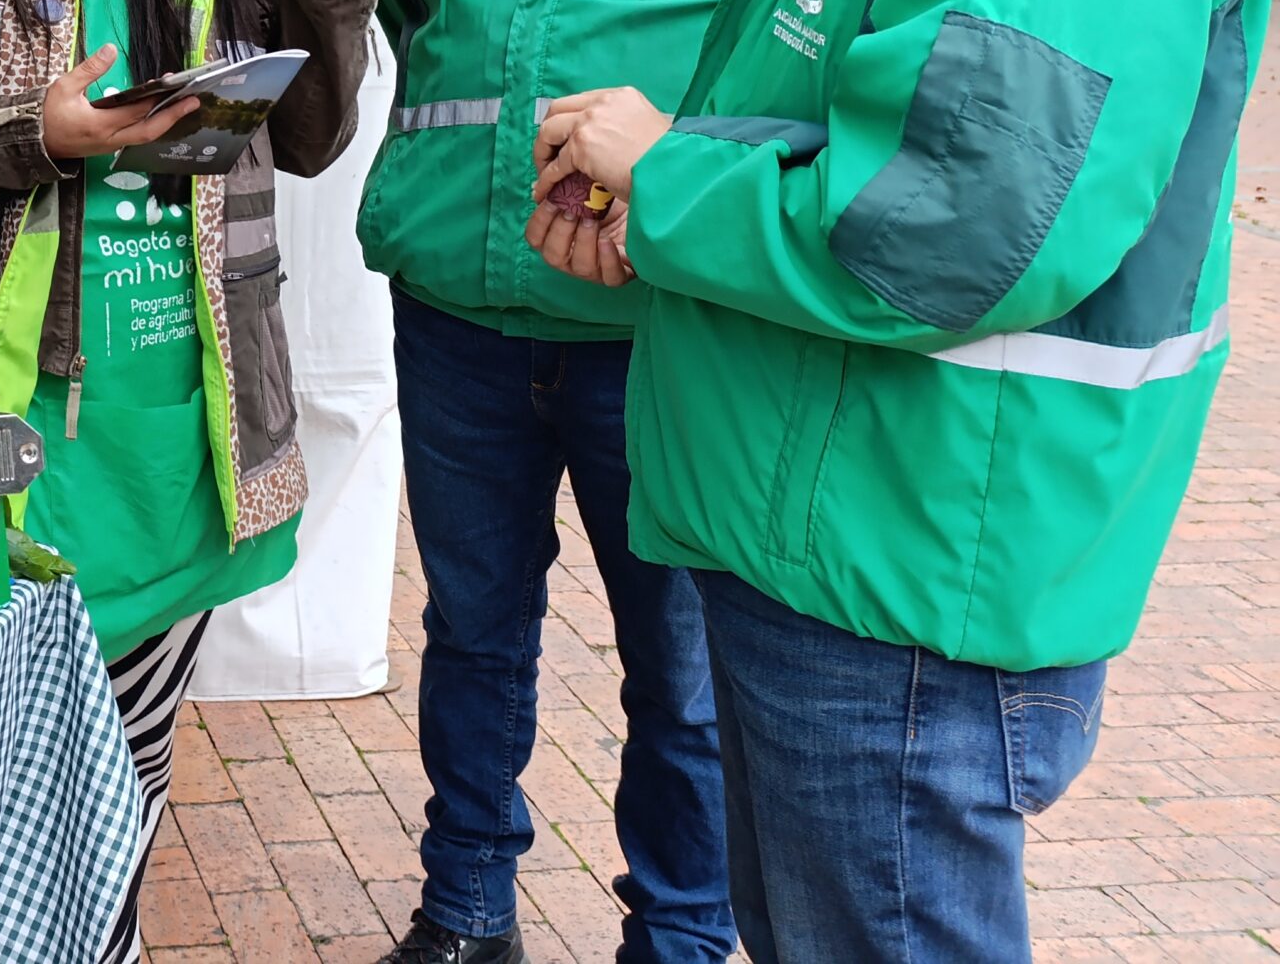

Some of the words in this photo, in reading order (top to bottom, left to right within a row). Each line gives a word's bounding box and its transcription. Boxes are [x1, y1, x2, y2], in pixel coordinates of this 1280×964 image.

[98, 230, 171, 257] Bogotá
[104, 262, 141, 288] mi
[146, 256, 194, 282] hue
[130, 293, 184, 315] Programa
[130, 316, 146, 331] de
[148, 306, 196, 330] agricultu
[131, 336, 139, 352] y
[140, 323, 196, 350] periurbana
